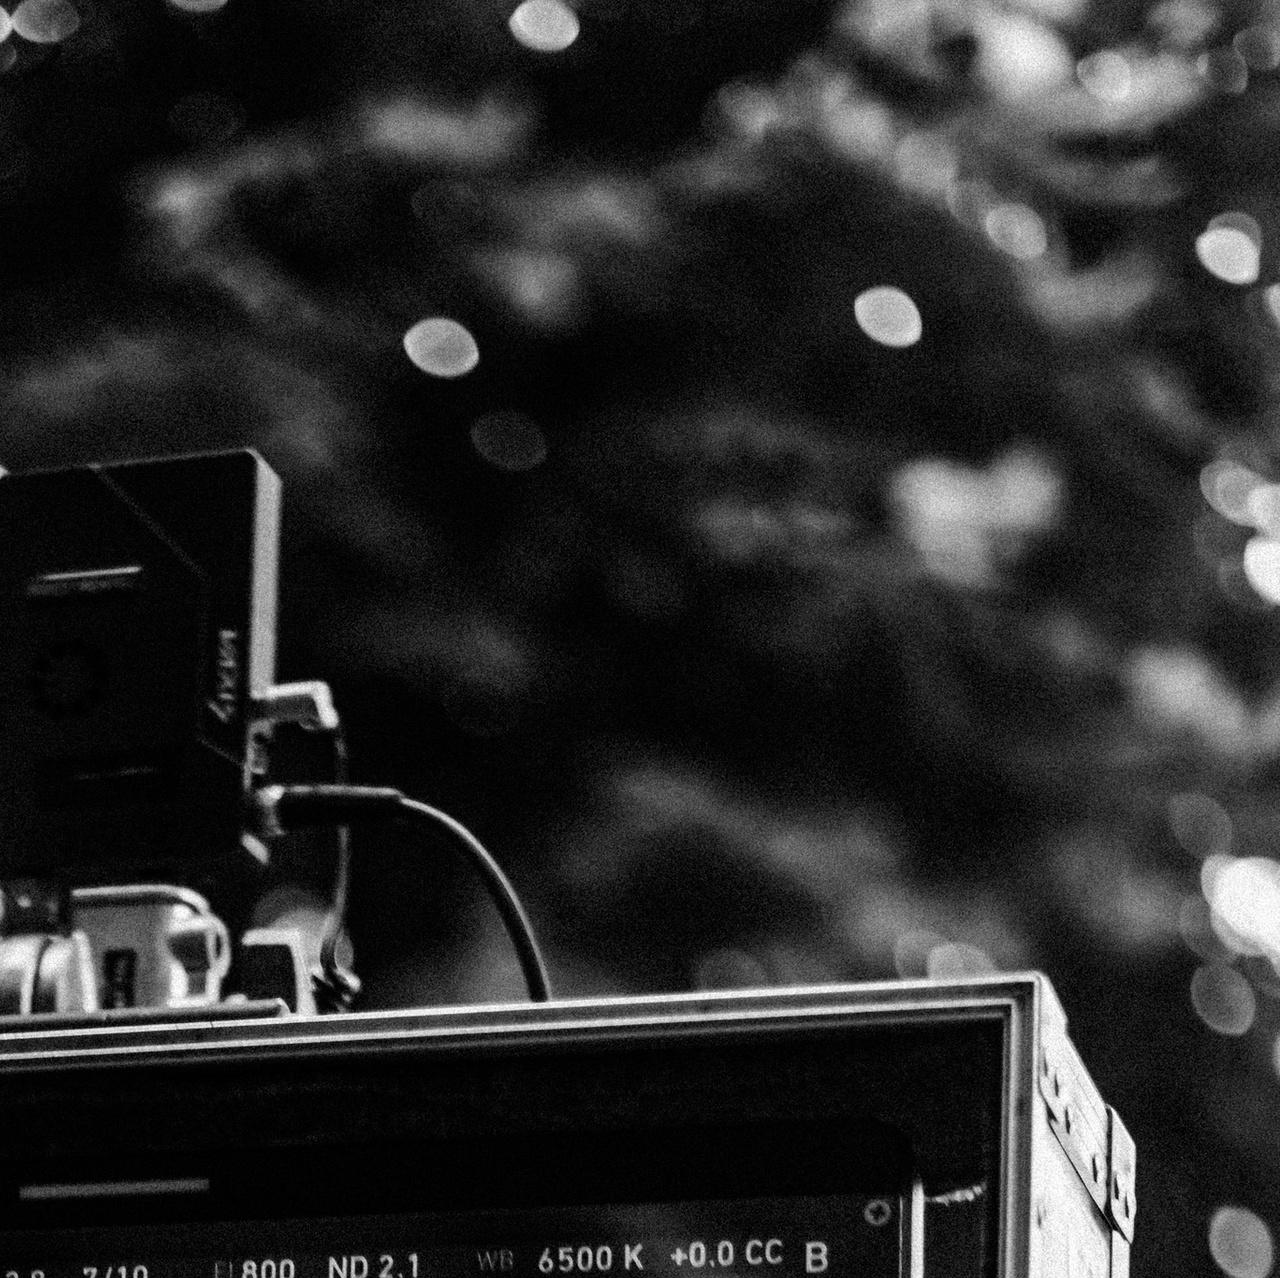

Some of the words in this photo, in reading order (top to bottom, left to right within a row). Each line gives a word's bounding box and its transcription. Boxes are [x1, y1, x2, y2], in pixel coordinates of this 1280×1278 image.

[476, 1247, 515, 1273] WB
[538, 1245, 613, 1274] 6500
[623, 1243, 645, 1271] K
[745, 1238, 784, 1265] CC
[805, 1240, 830, 1274] B
